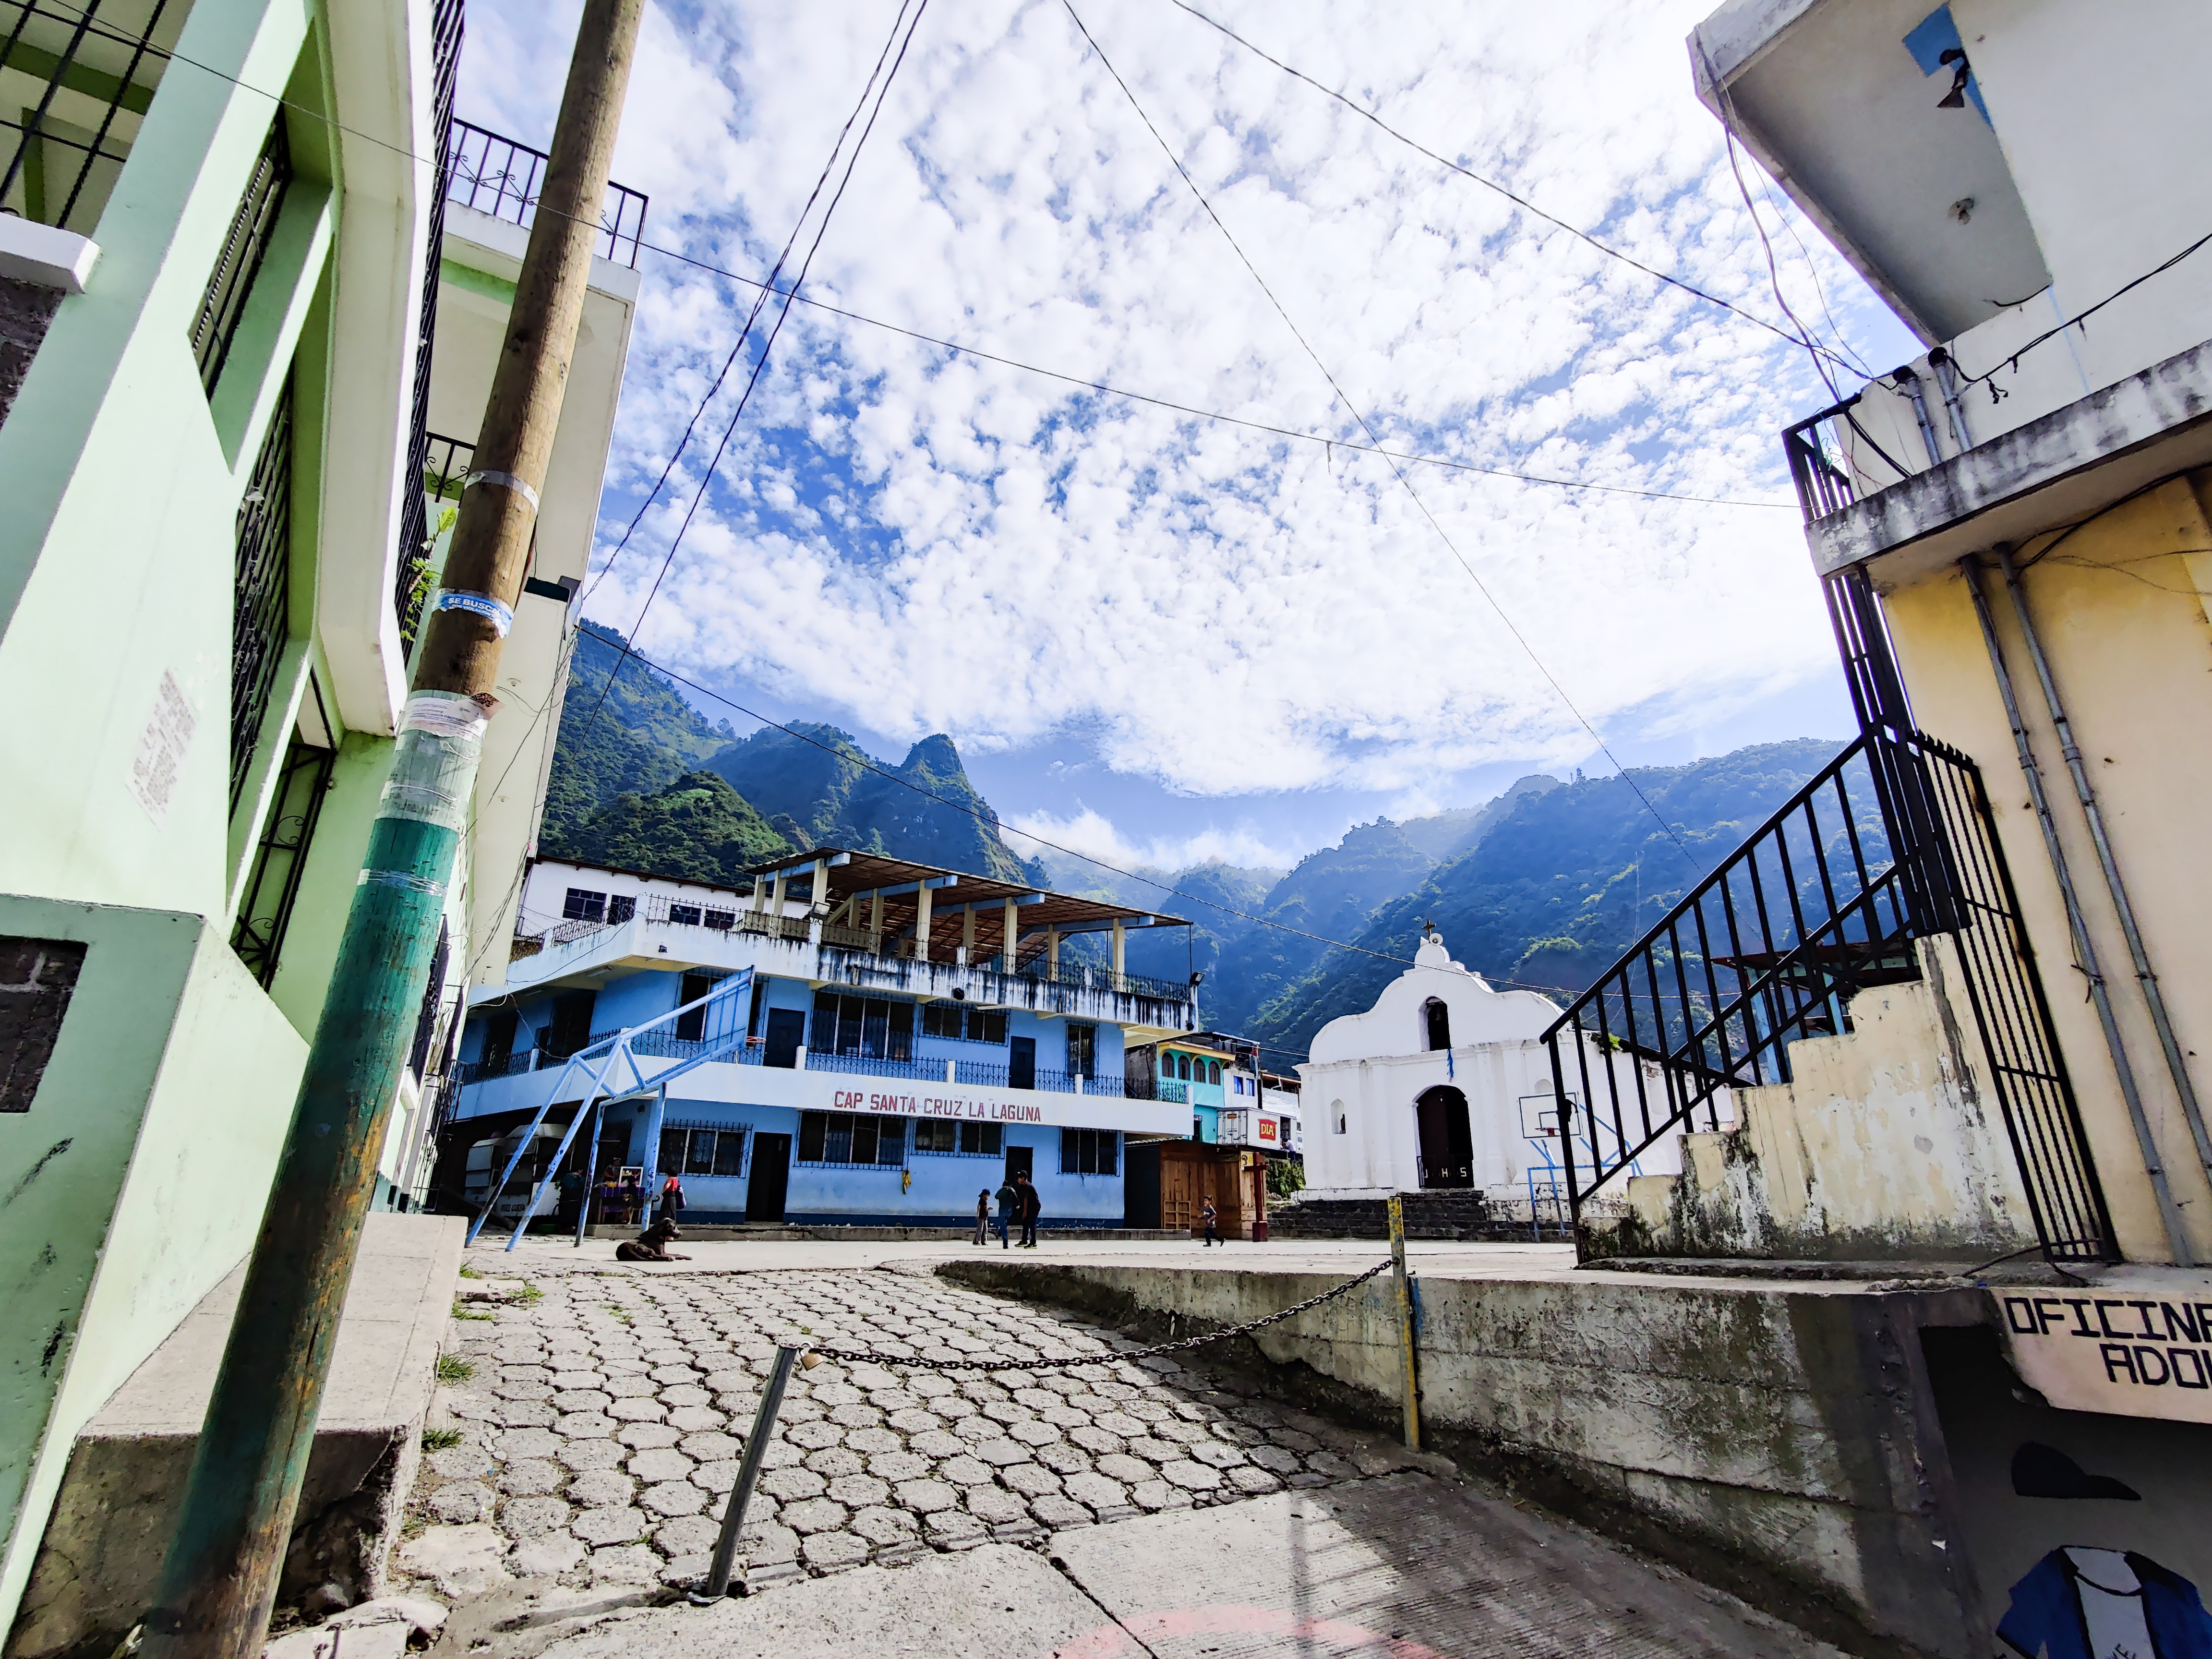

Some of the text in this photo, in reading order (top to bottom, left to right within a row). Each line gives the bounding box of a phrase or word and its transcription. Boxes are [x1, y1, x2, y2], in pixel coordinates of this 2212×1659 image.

[463, 599, 501, 614] BUSCA
[834, 1091, 1041, 1122] CAP SANTA CRUZ LA LAGUNA
[2099, 1343, 2212, 1389] ADO
